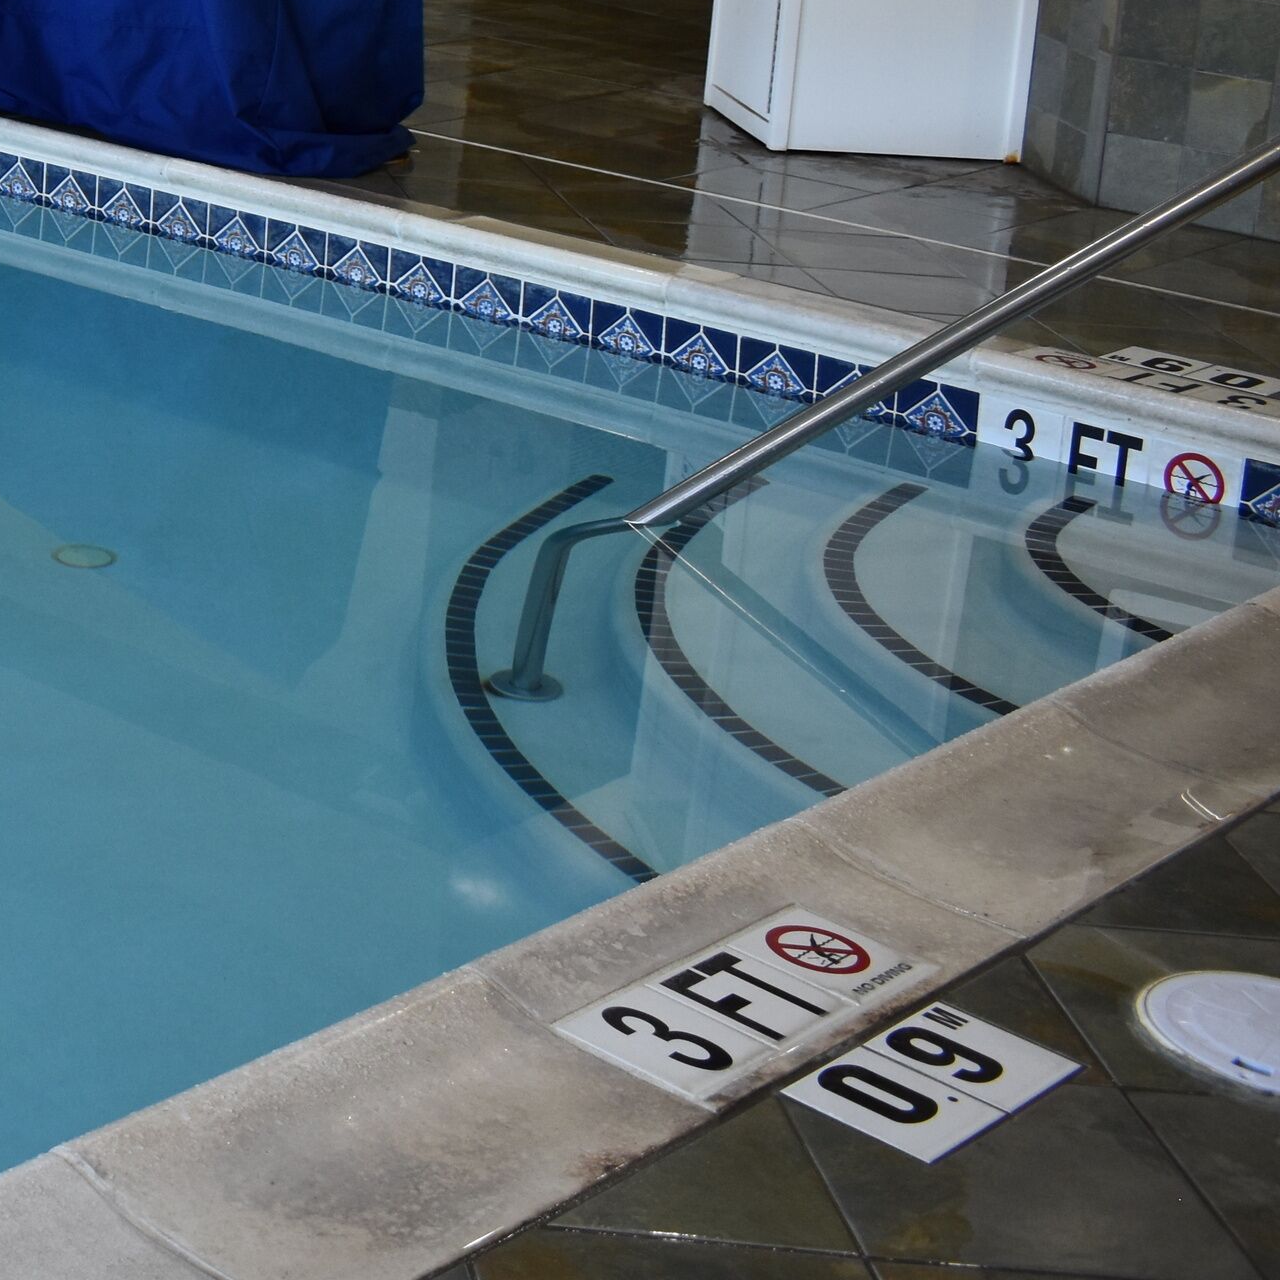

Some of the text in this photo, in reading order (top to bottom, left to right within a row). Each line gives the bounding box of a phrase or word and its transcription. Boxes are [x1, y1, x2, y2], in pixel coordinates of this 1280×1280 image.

[1004, 408, 1144, 487] 3 FT
[601, 951, 830, 1071] 3 FT
[852, 962, 913, 996] NO DIVING
